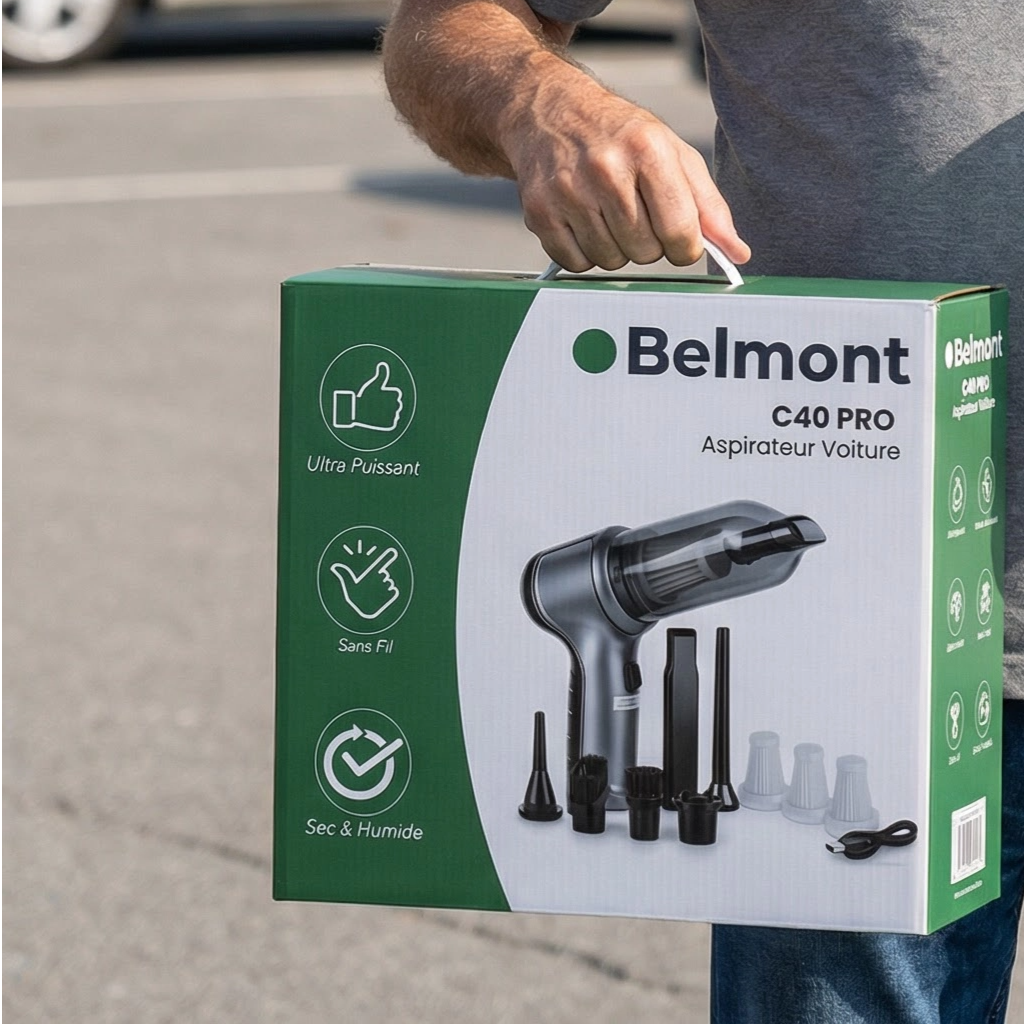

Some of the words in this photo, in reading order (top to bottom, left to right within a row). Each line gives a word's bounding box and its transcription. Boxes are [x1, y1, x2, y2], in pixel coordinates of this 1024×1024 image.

[627, 326, 911, 385] Belmont
[954, 330, 1003, 367] Belmont
[771, 405, 830, 429] C40
[837, 407, 895, 431] PRO
[701, 435, 816, 460] Aspirateur
[821, 438, 901, 460] Voiture
[307, 455, 346, 473] Ultra
[351, 457, 420, 476] Puissant
[338, 638, 372, 653] Sans
[376, 639, 394, 654] Fil
[305, 818, 337, 836] Sec
[340, 820, 353, 837] &
[357, 821, 424, 840] Humide
